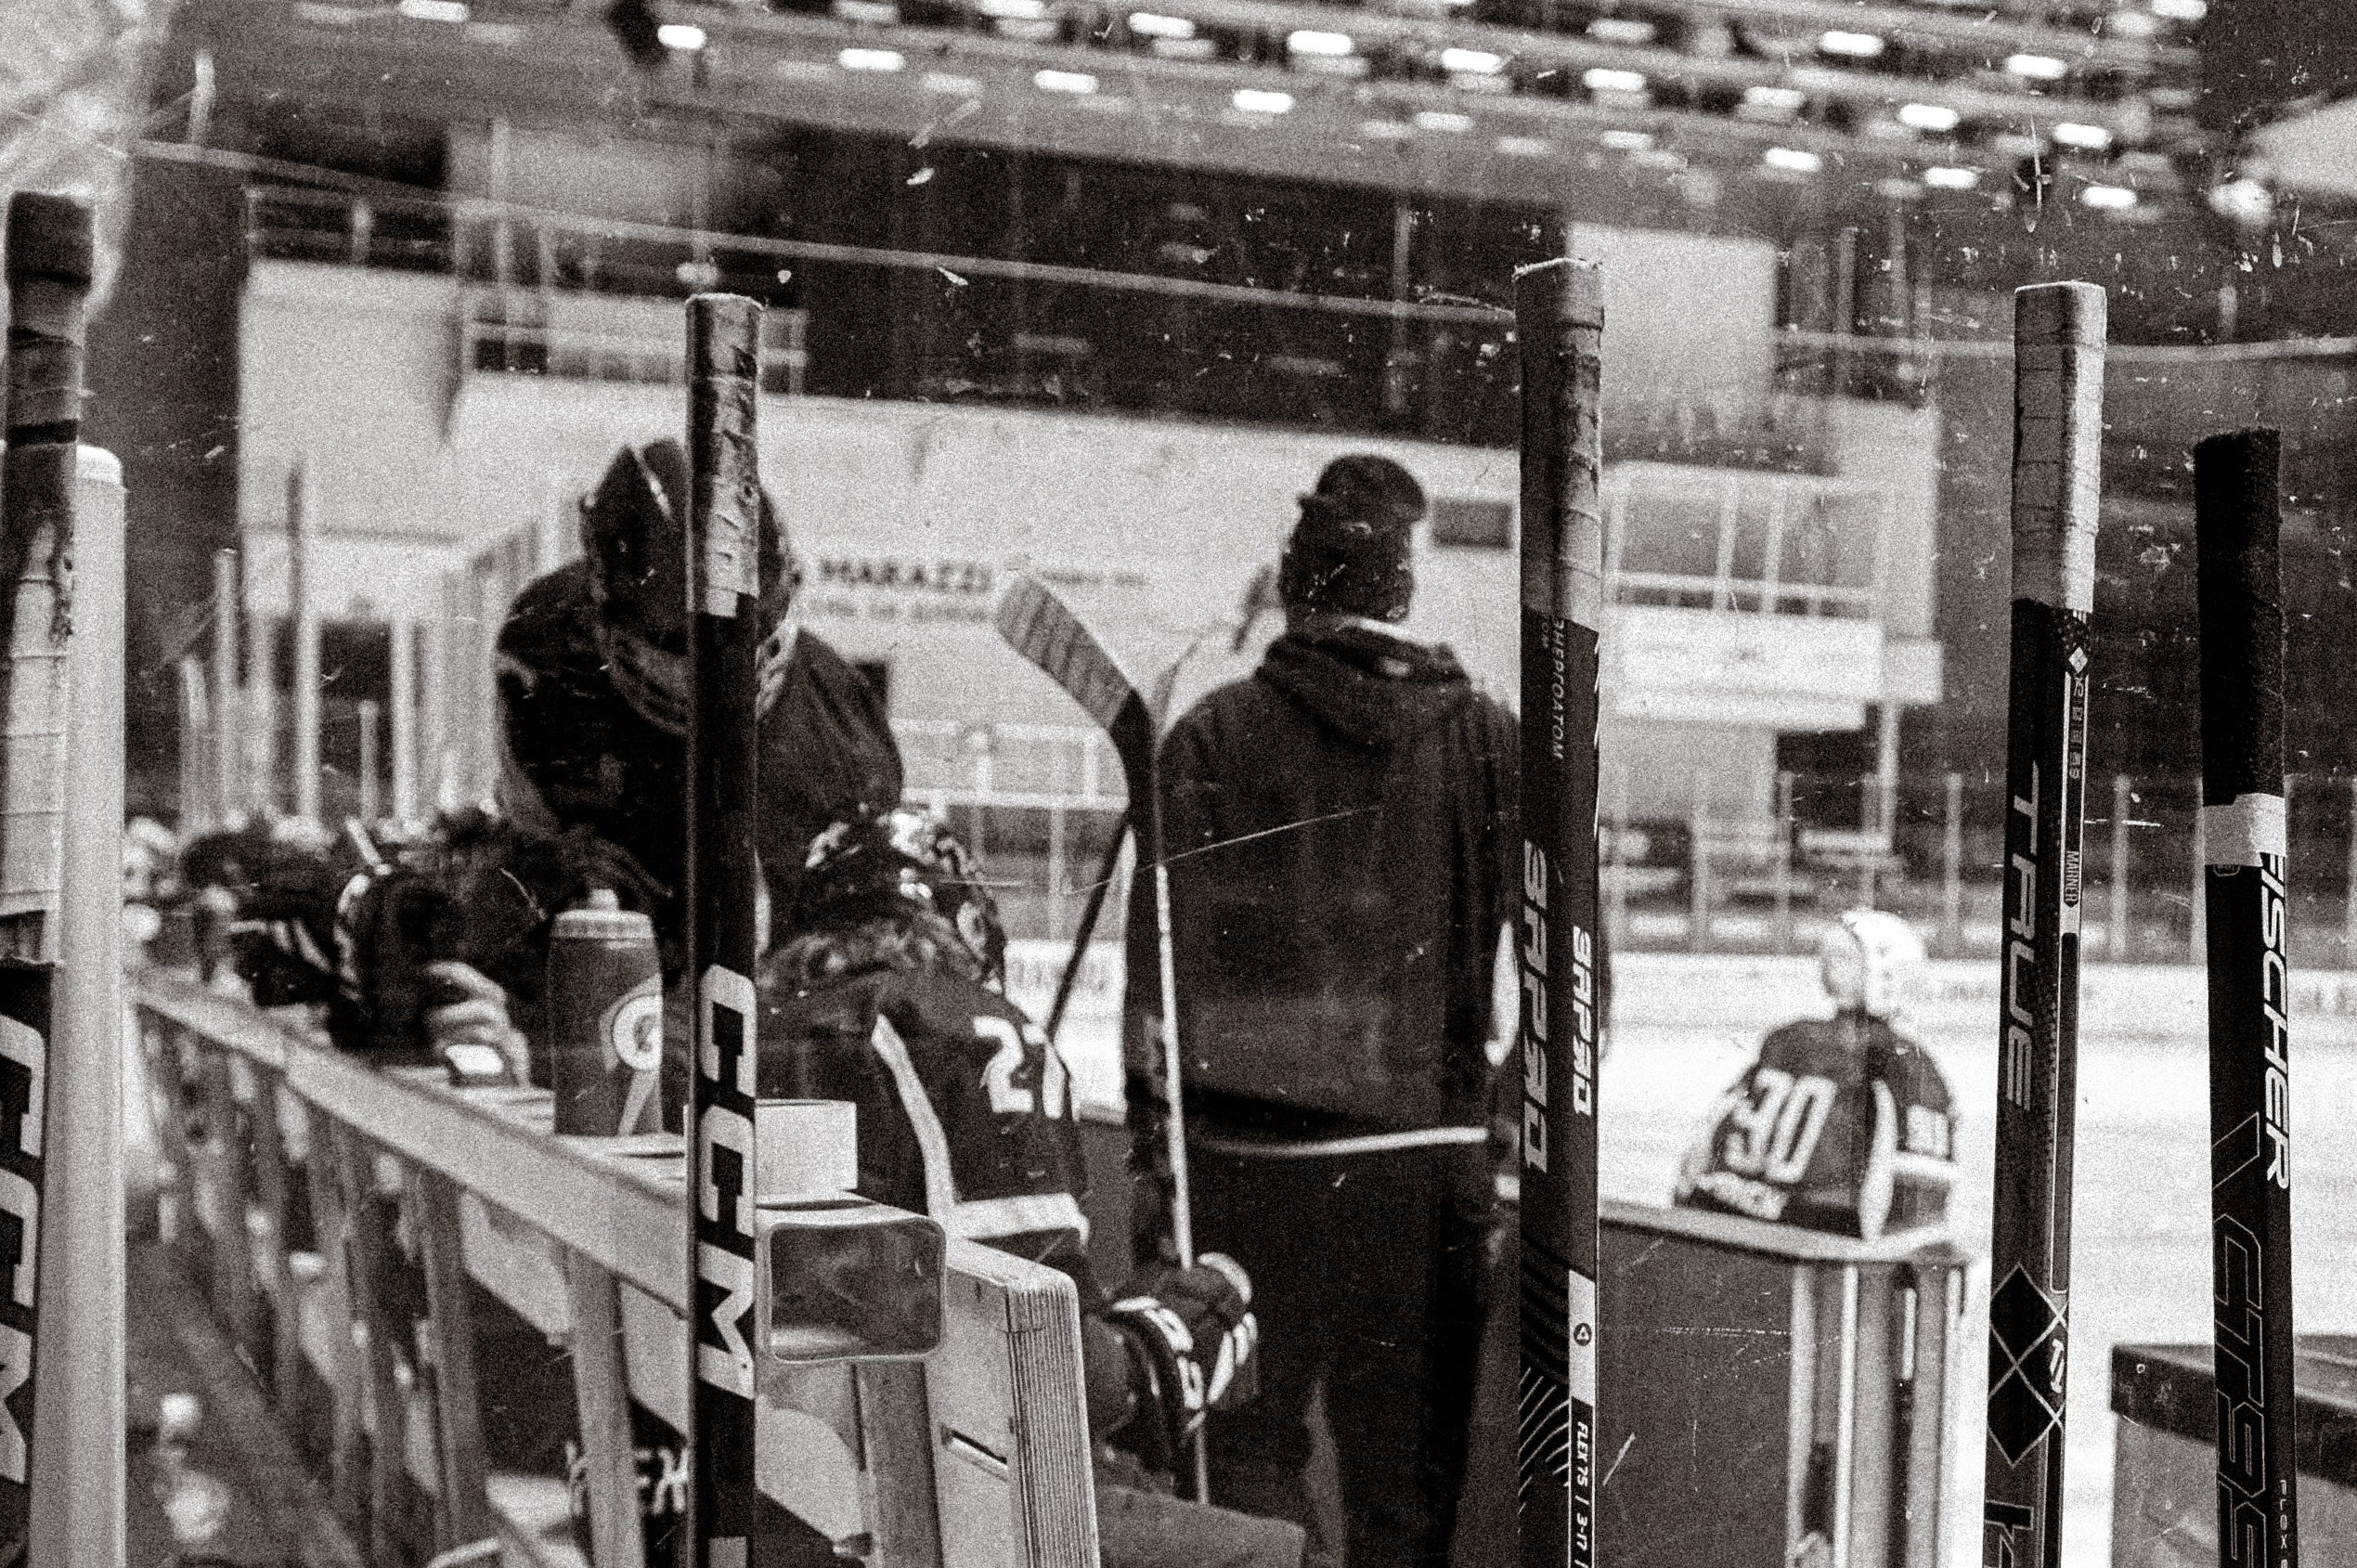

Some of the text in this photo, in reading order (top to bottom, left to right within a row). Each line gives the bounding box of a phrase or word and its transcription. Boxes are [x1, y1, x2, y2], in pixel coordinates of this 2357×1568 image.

[2006, 760, 2040, 1111] TRUE
[2064, 850, 2079, 904] MARNER
[698, 964, 757, 1400] CCM
